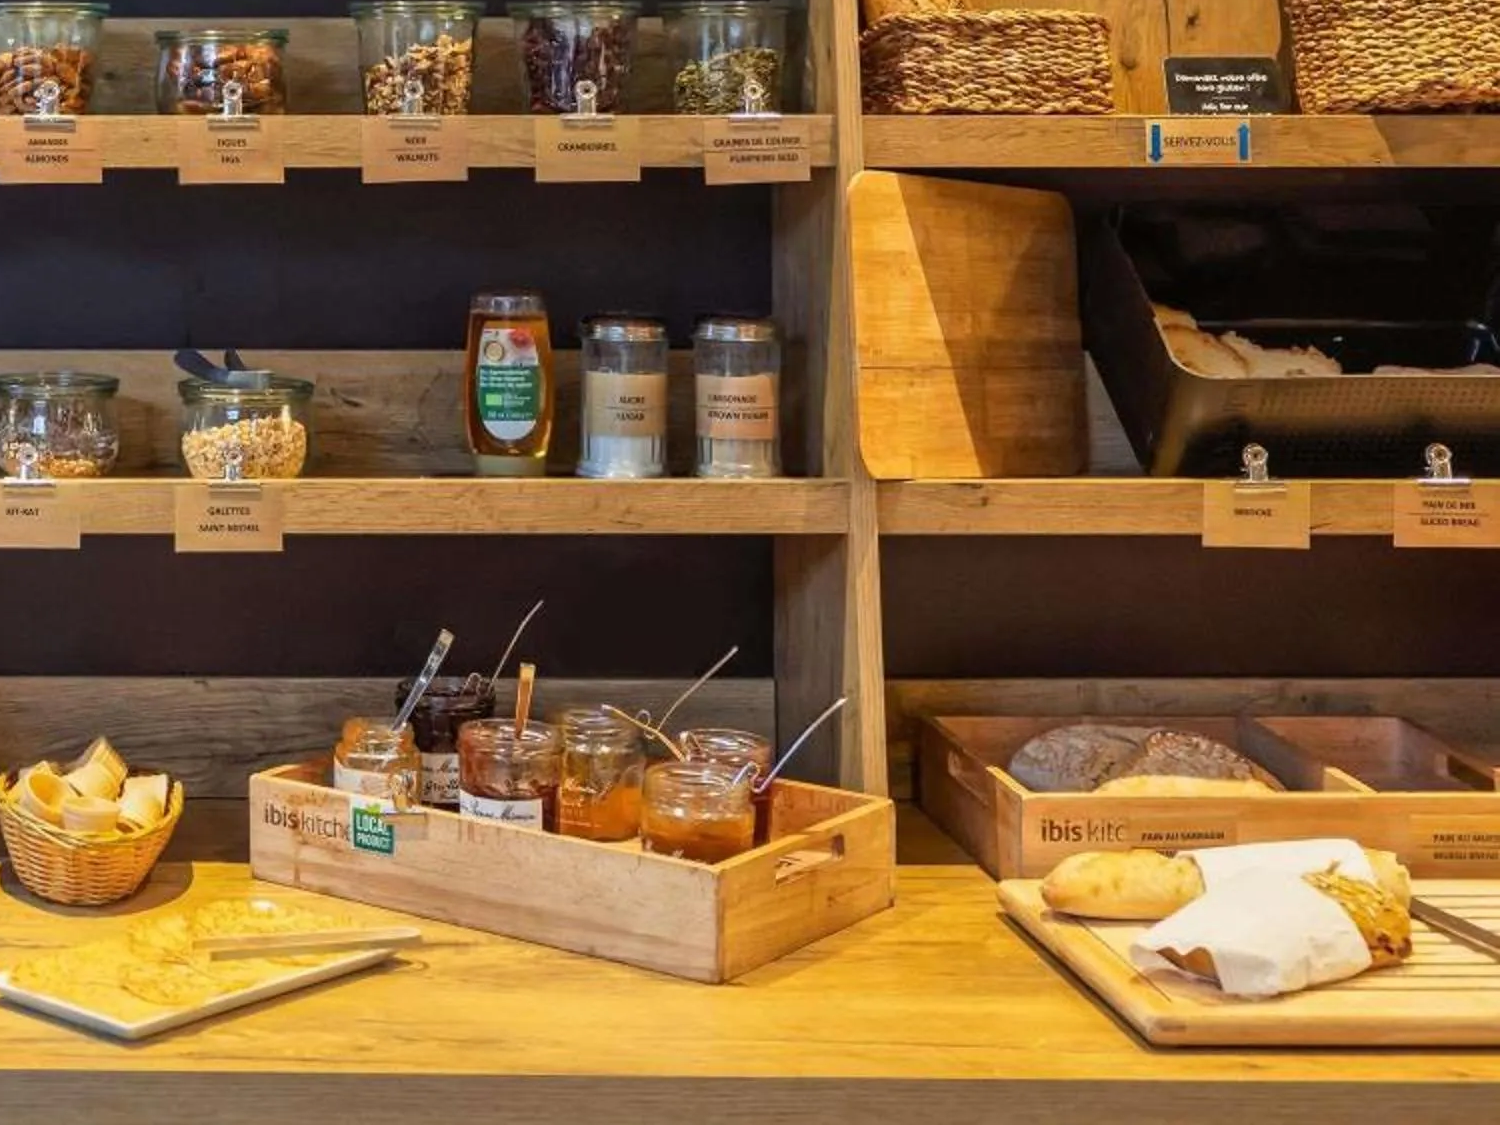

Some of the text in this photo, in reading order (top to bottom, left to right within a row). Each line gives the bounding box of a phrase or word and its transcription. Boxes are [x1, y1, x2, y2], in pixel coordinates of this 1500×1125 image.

[217, 138, 247, 148] FIGUES
[396, 153, 440, 163] WALNUTS
[207, 505, 251, 516] GALETTES
[265, 803, 299, 830] ibis
[1041, 819, 1125, 843] ibis kitc
